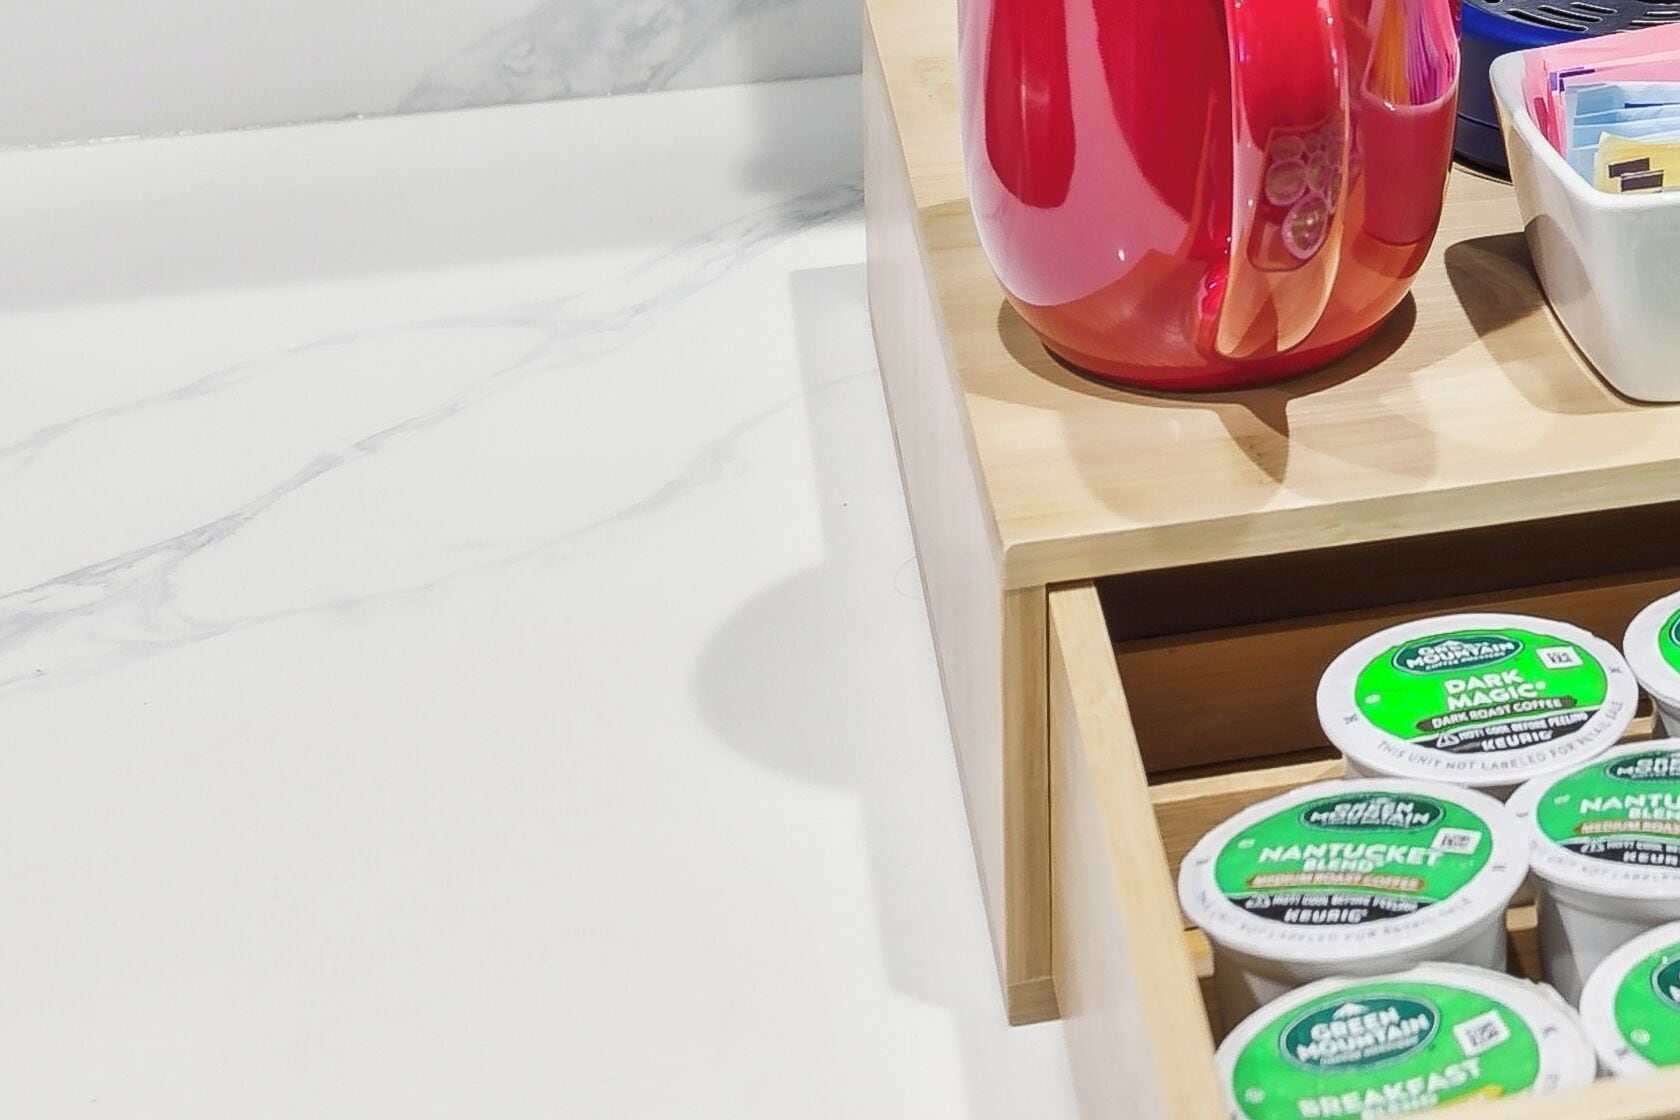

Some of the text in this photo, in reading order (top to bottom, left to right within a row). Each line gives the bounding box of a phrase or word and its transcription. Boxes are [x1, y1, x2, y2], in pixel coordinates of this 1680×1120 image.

[1407, 642, 1515, 668] MOUNTAIN
[1444, 669, 1523, 695] DARK
[1431, 699, 1563, 729] DARK ROAST COFFEE
[1481, 730, 1554, 753] KEURIG
[1445, 761, 1475, 771] NOT
[1258, 843, 1444, 867] NANTUCKET
[1310, 1006, 1400, 1042] GREEN
[1297, 1056, 1481, 1118] BREAKFAST
